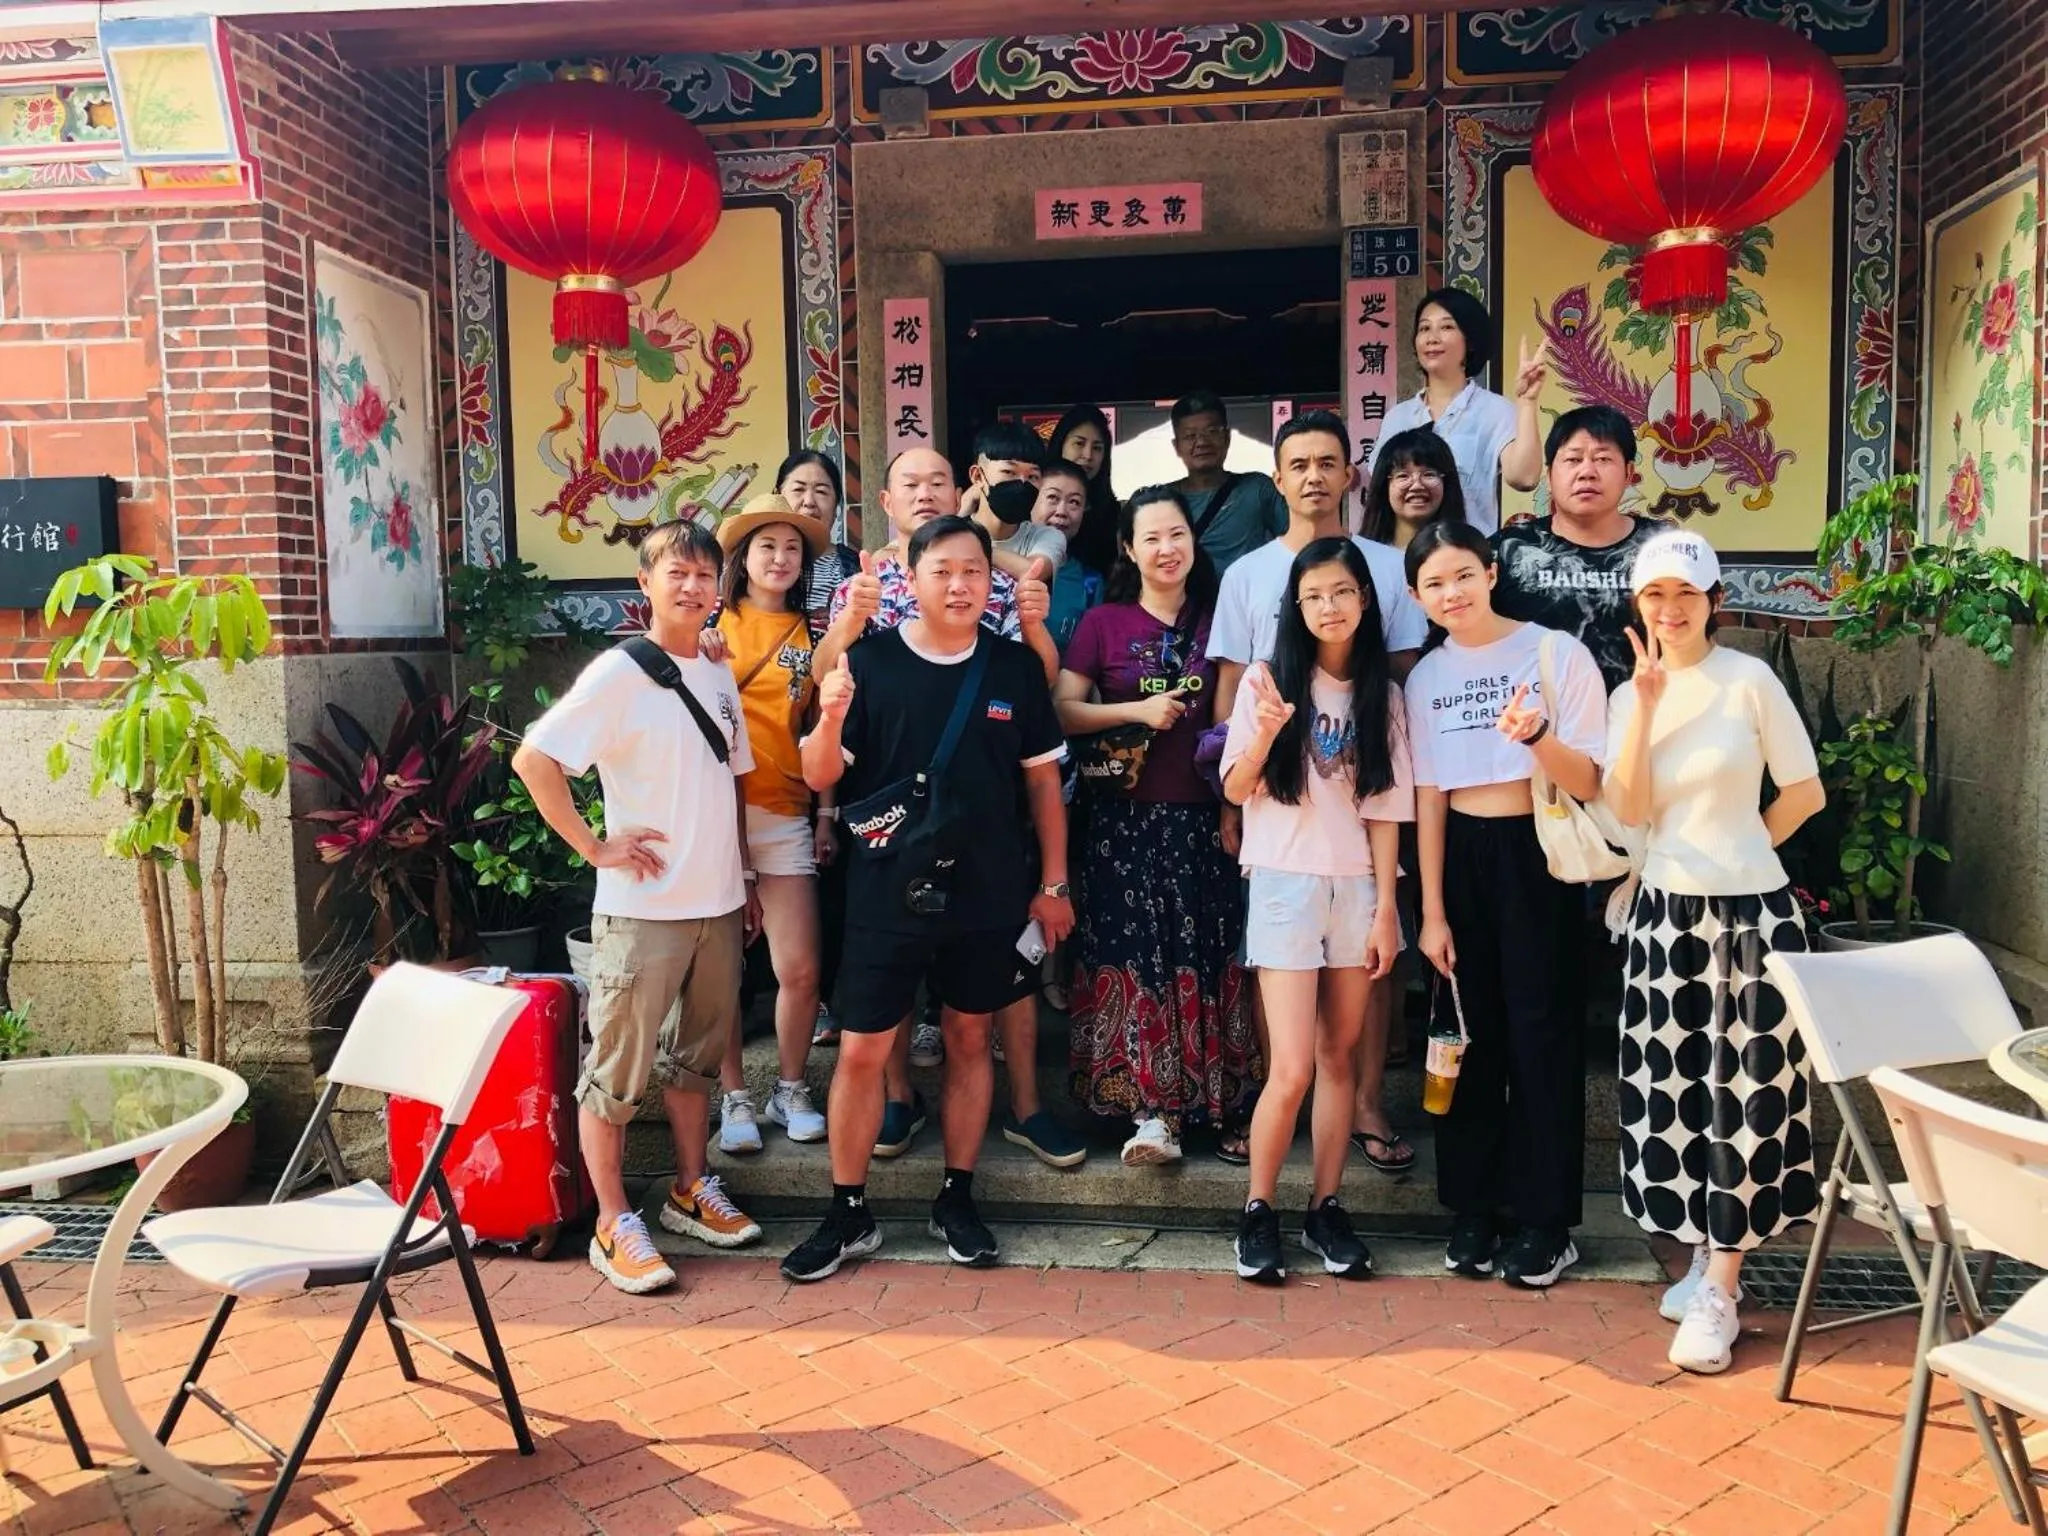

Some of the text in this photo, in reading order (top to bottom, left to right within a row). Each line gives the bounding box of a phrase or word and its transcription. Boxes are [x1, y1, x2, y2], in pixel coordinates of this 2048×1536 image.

[1374, 254, 1411, 275] 50
[1, 522, 61, 552] 行館
[1537, 570, 1634, 589] BAOSHI
[1432, 681, 1541, 710] SUPPORTIG
[1464, 675, 1509, 691] GIRLS
[848, 804, 907, 836] Reebok
